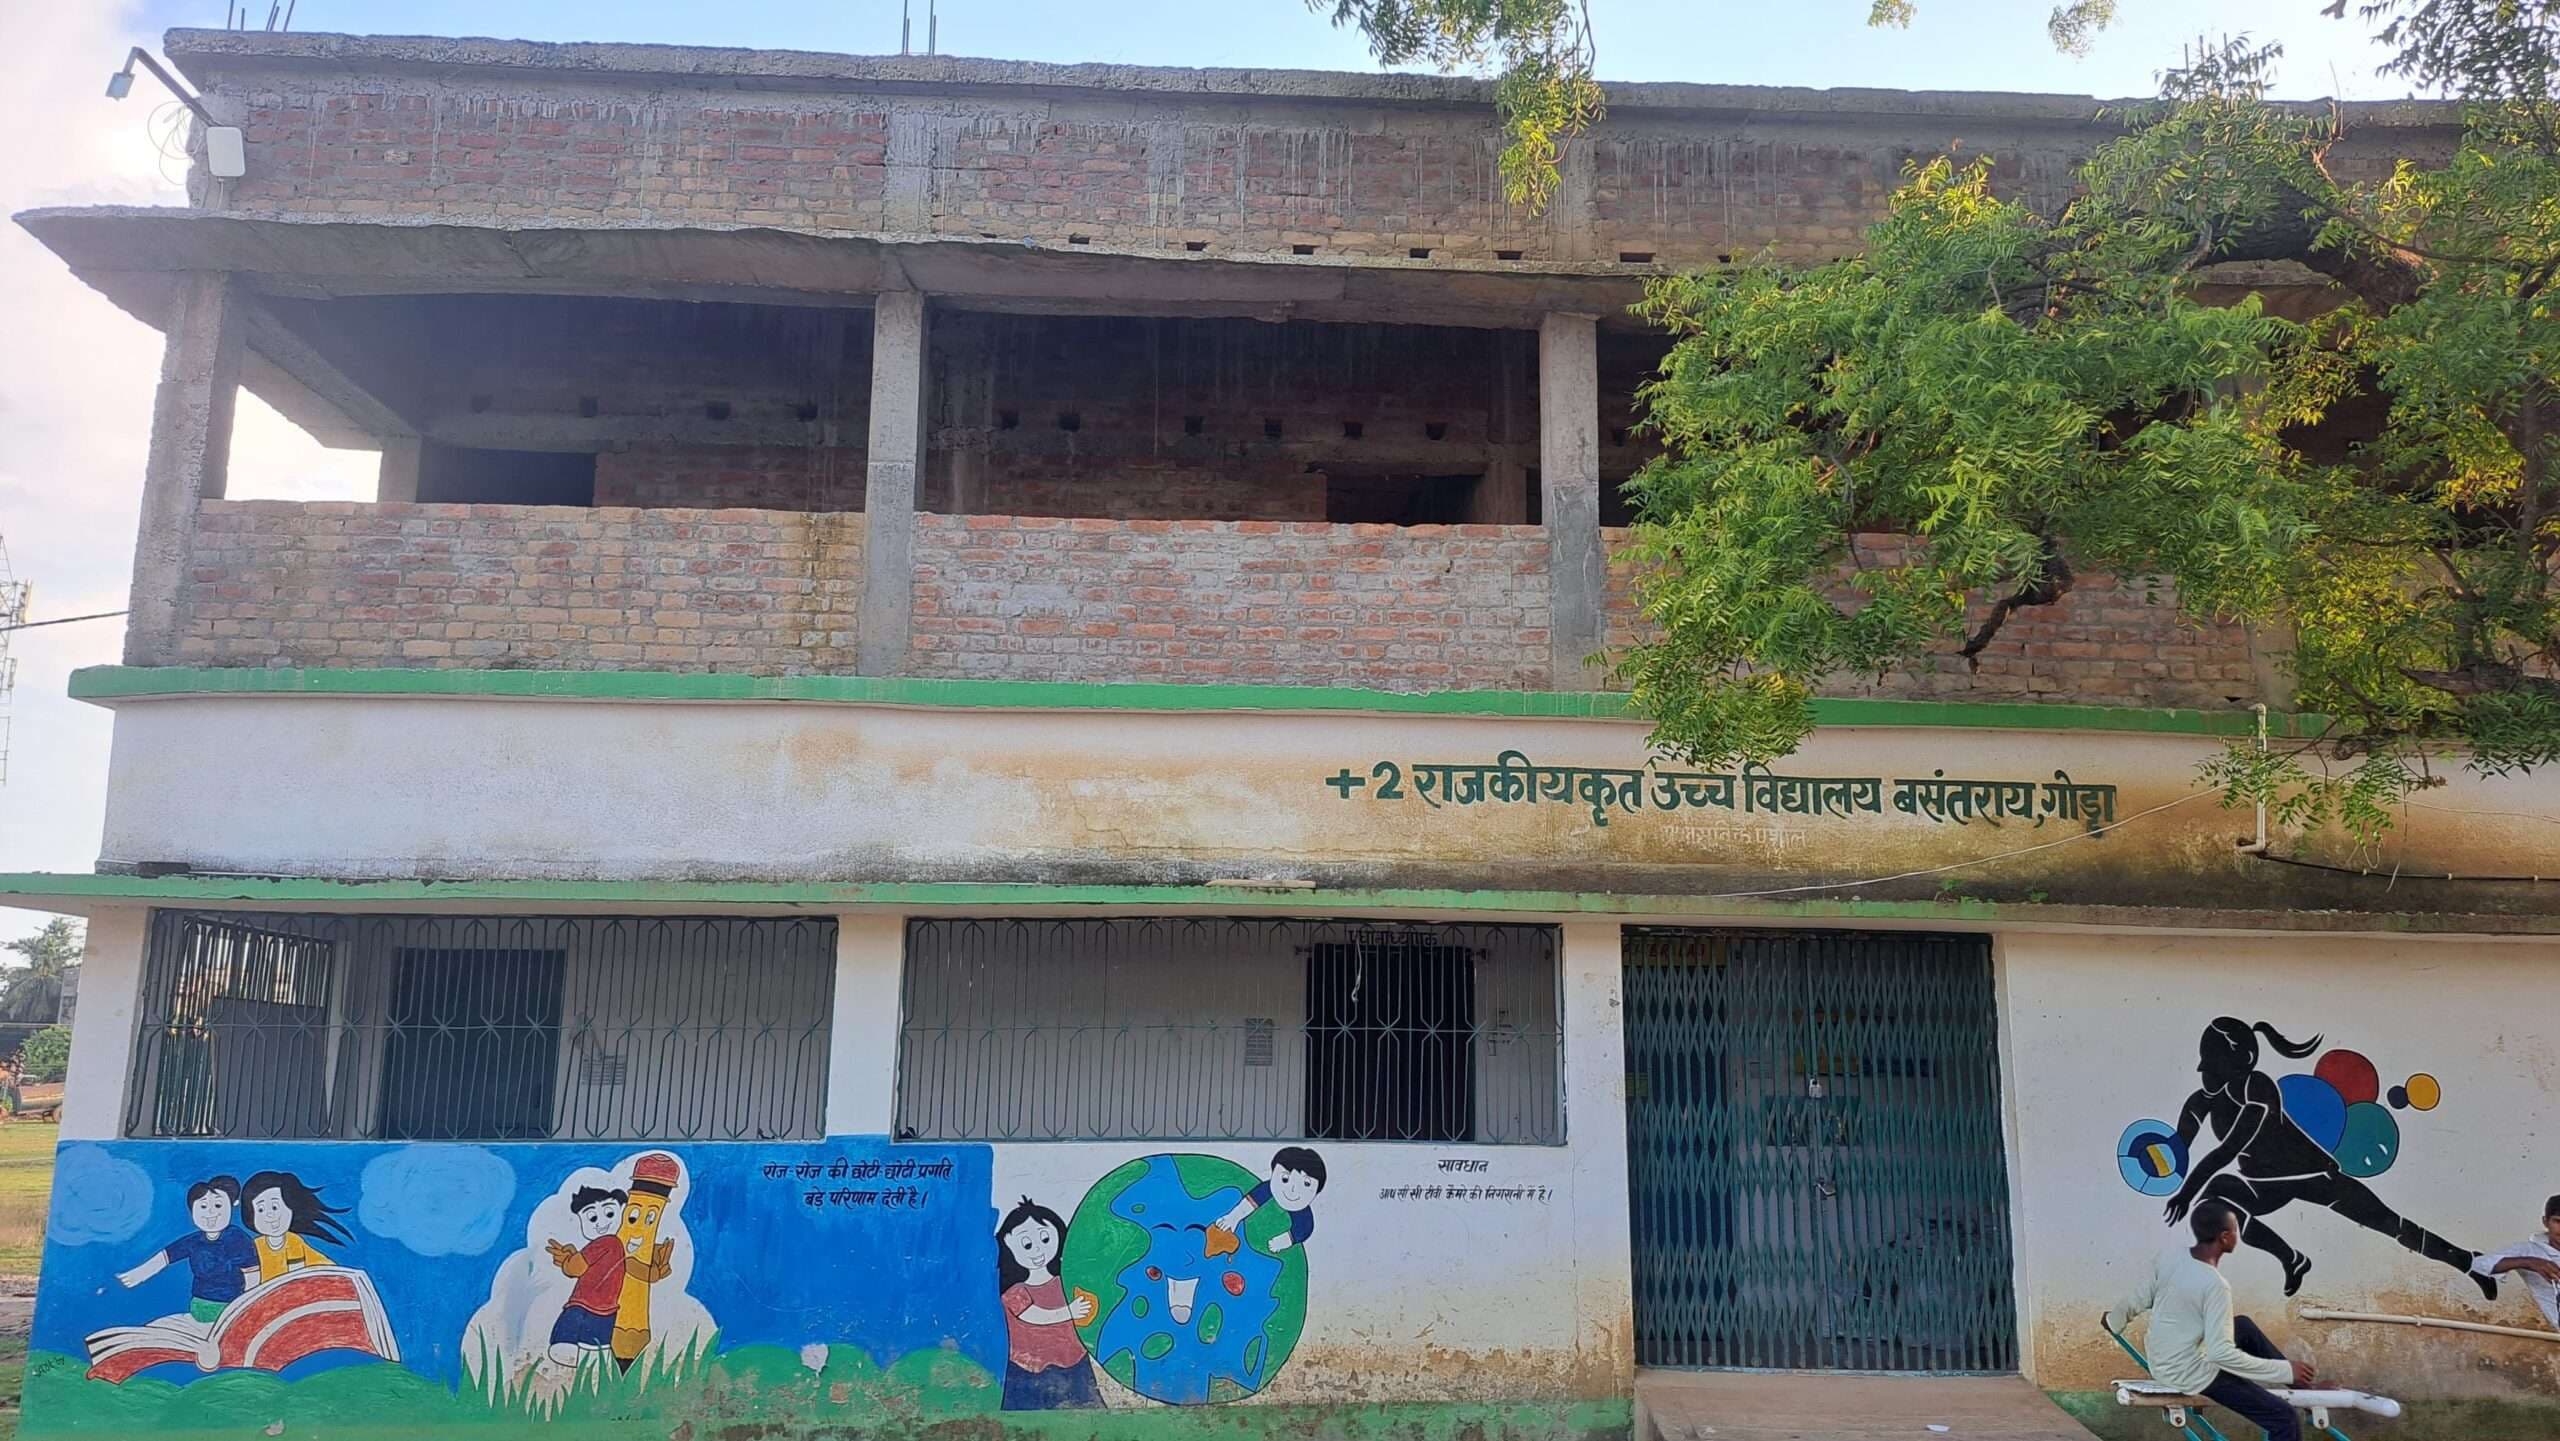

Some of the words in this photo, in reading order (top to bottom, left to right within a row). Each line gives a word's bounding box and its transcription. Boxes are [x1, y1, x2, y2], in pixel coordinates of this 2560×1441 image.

[1412, 750, 1645, 827] राजकीयकृत
[1651, 770, 1738, 812] उच्च
[1742, 761, 1882, 819] विद्यालय
[826, 1157, 849, 1179] की
[914, 1157, 955, 1181] प्रगति
[1437, 1159, 1489, 1176] सावधान
[828, 1187, 880, 1210] परिणाम
[880, 1187, 906, 1210] देती
[1469, 1184, 1483, 1201] की
[1485, 1183, 1526, 1206] निगरानी
